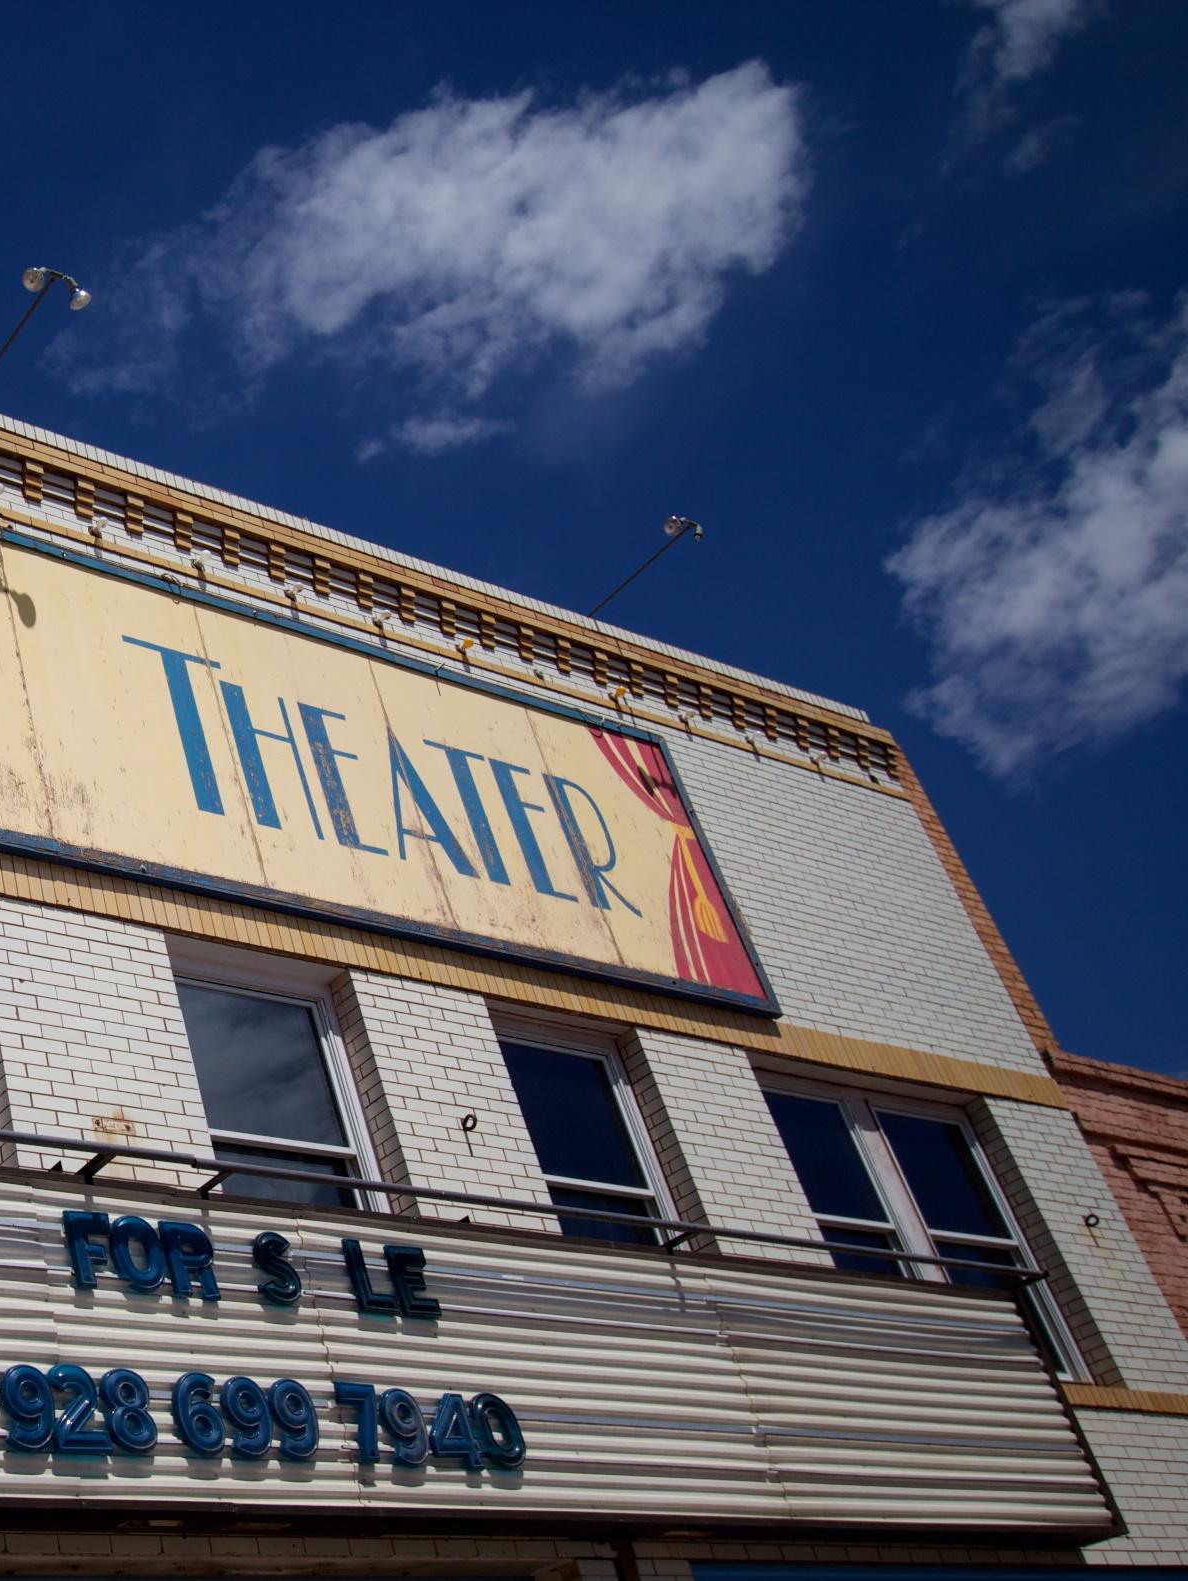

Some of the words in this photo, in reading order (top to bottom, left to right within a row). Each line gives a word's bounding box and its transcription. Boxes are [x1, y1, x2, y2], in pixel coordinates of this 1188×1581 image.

[122, 635, 642, 918] THEATER
[62, 1210, 221, 1301] FOR
[0, 1363, 158, 1456] 928
[171, 1371, 320, 1459] 699
[334, 1380, 526, 1471] 7940
